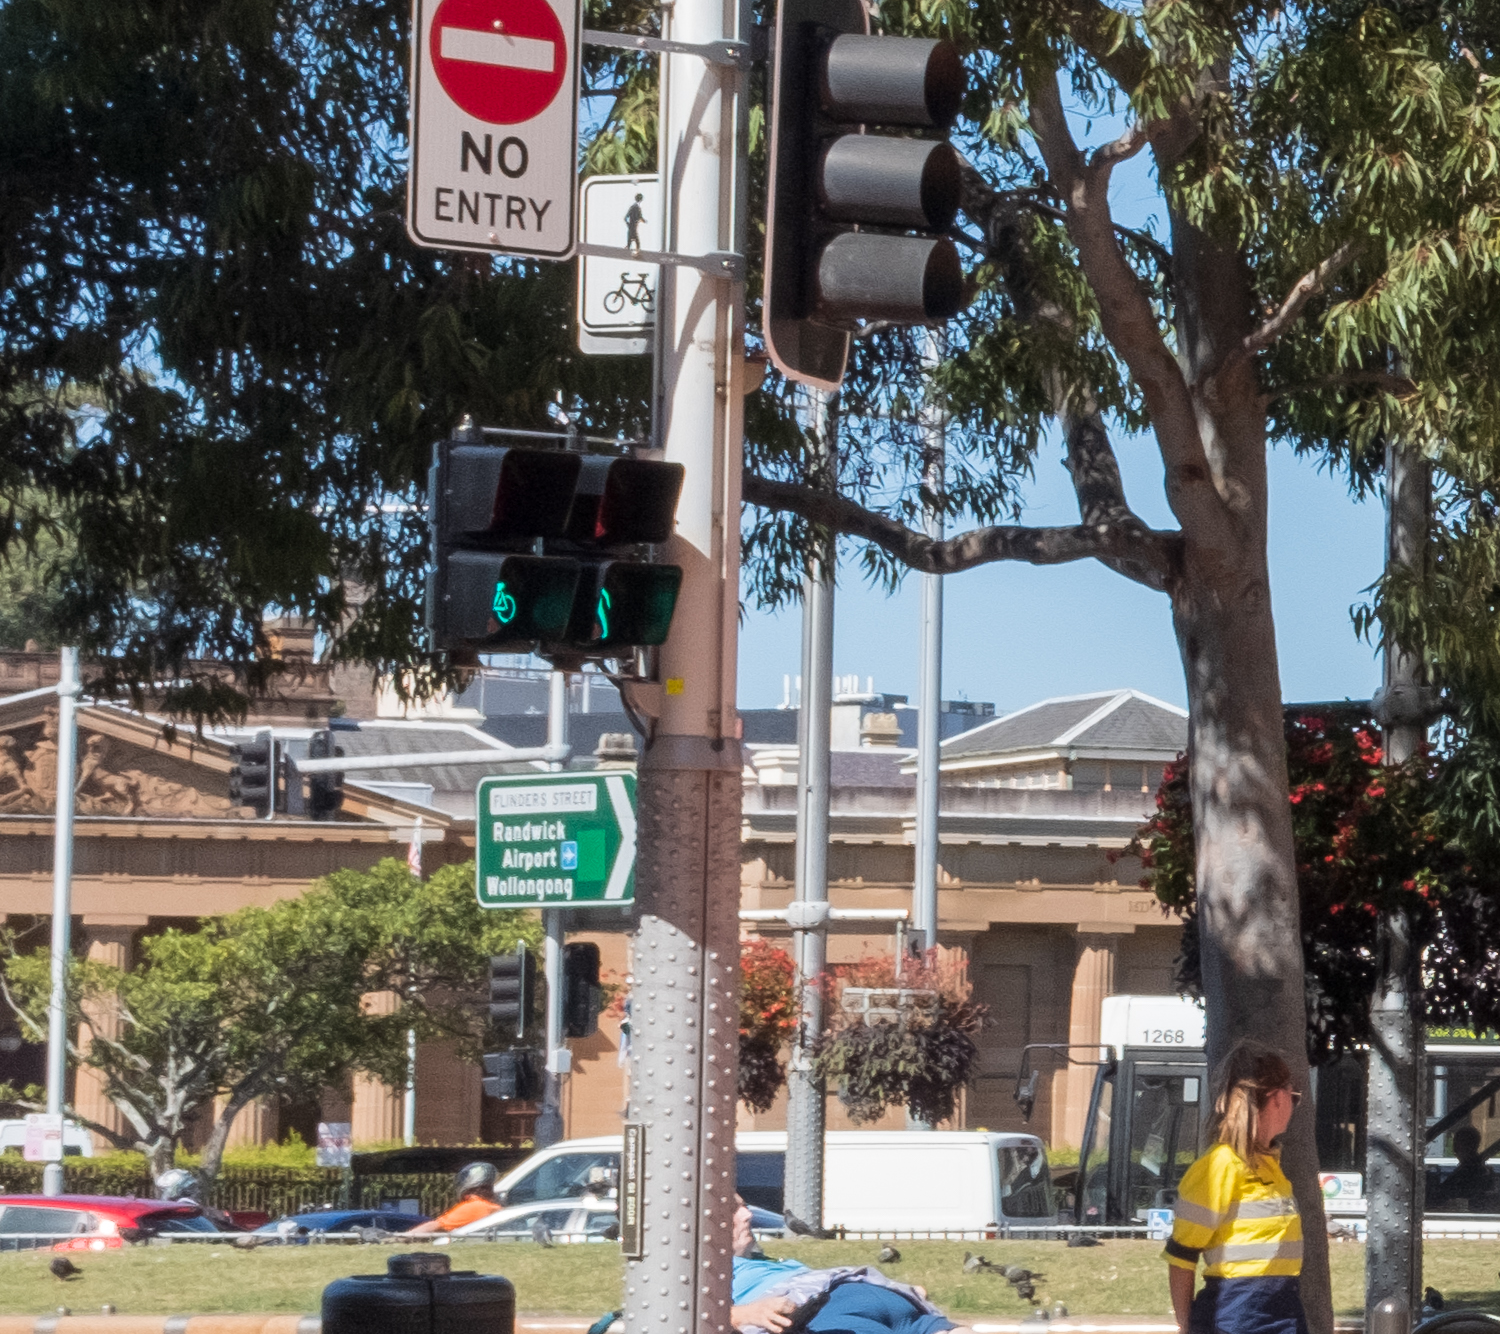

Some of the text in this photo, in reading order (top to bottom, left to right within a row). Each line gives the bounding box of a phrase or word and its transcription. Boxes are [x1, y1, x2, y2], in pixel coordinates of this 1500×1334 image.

[460, 133, 530, 178] NO
[433, 190, 552, 235] ENTRY
[493, 790, 594, 809] FLINDERS STREET
[493, 821, 567, 842] Randwick
[501, 848, 558, 873] Airport
[486, 875, 574, 901] Wollongong
[1143, 1029, 1186, 1045] 1268
